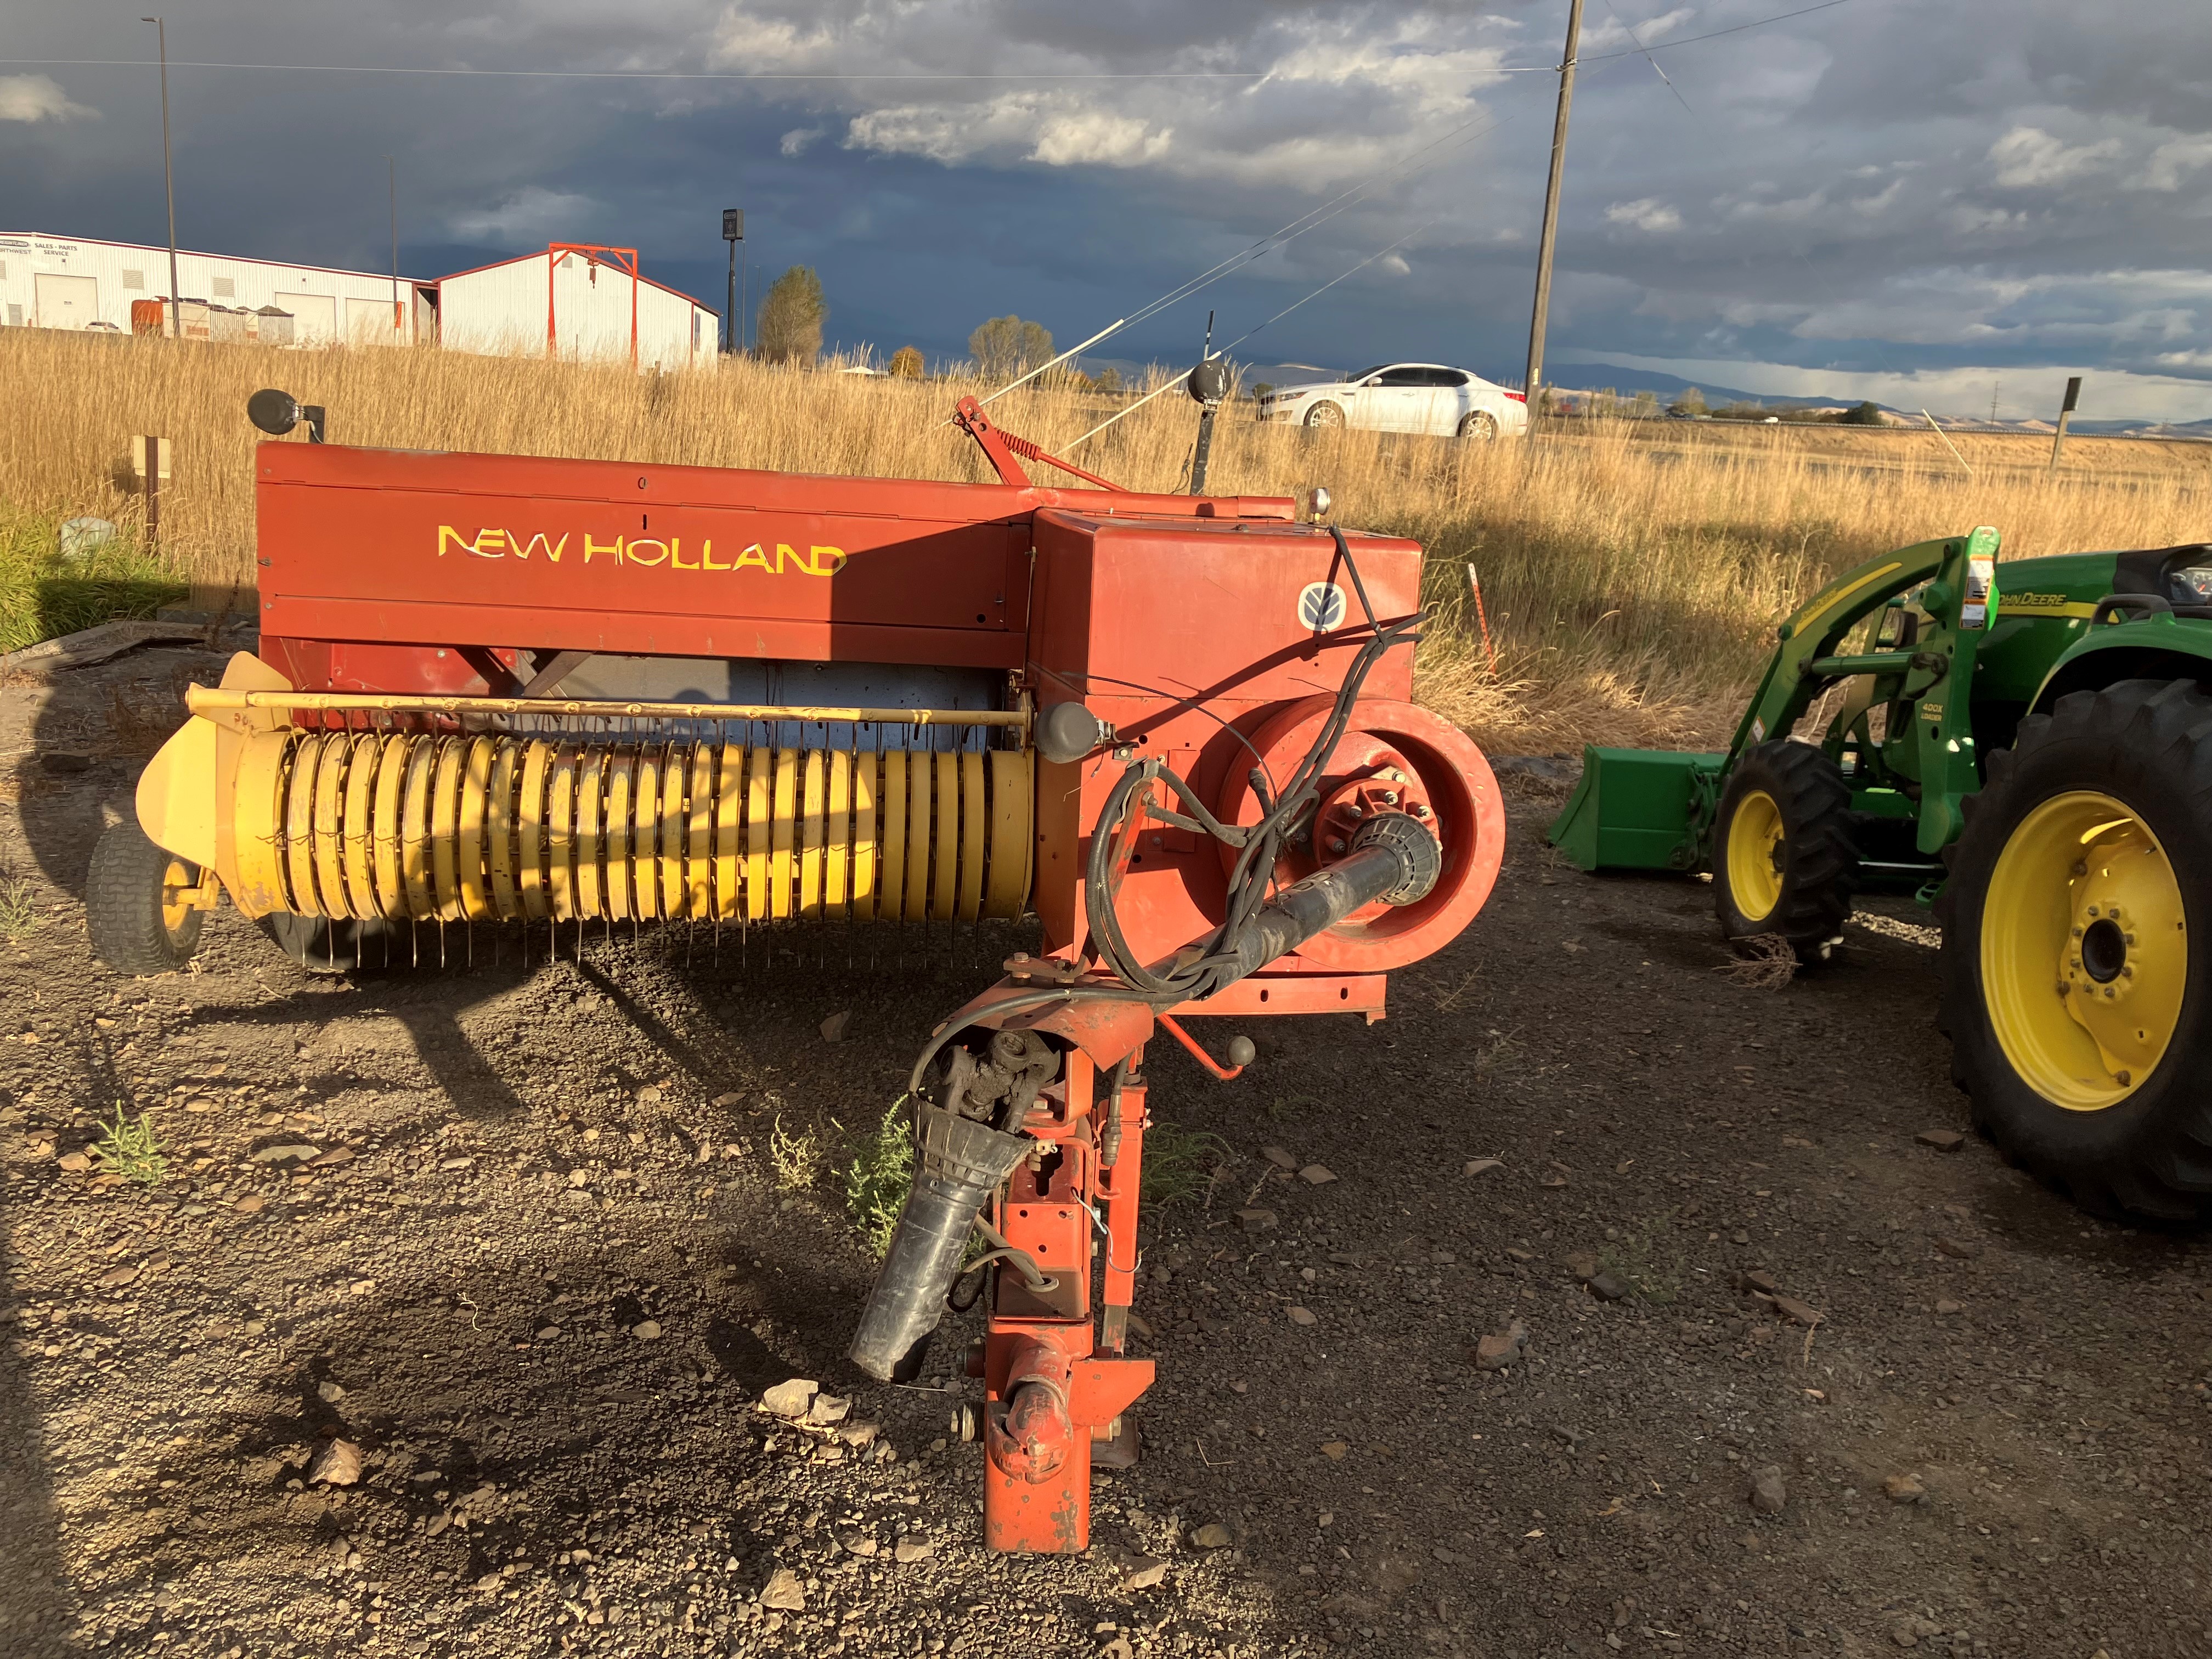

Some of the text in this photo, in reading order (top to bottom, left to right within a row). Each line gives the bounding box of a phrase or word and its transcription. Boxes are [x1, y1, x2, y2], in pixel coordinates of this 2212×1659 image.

[438, 525, 847, 577] NEW HOLLAND
[2000, 594, 2022, 606] OHN
[2021, 592, 2067, 605] DEERE
[1923, 703, 1943, 713] 400X
[1921, 713, 1942, 721] LOADER
